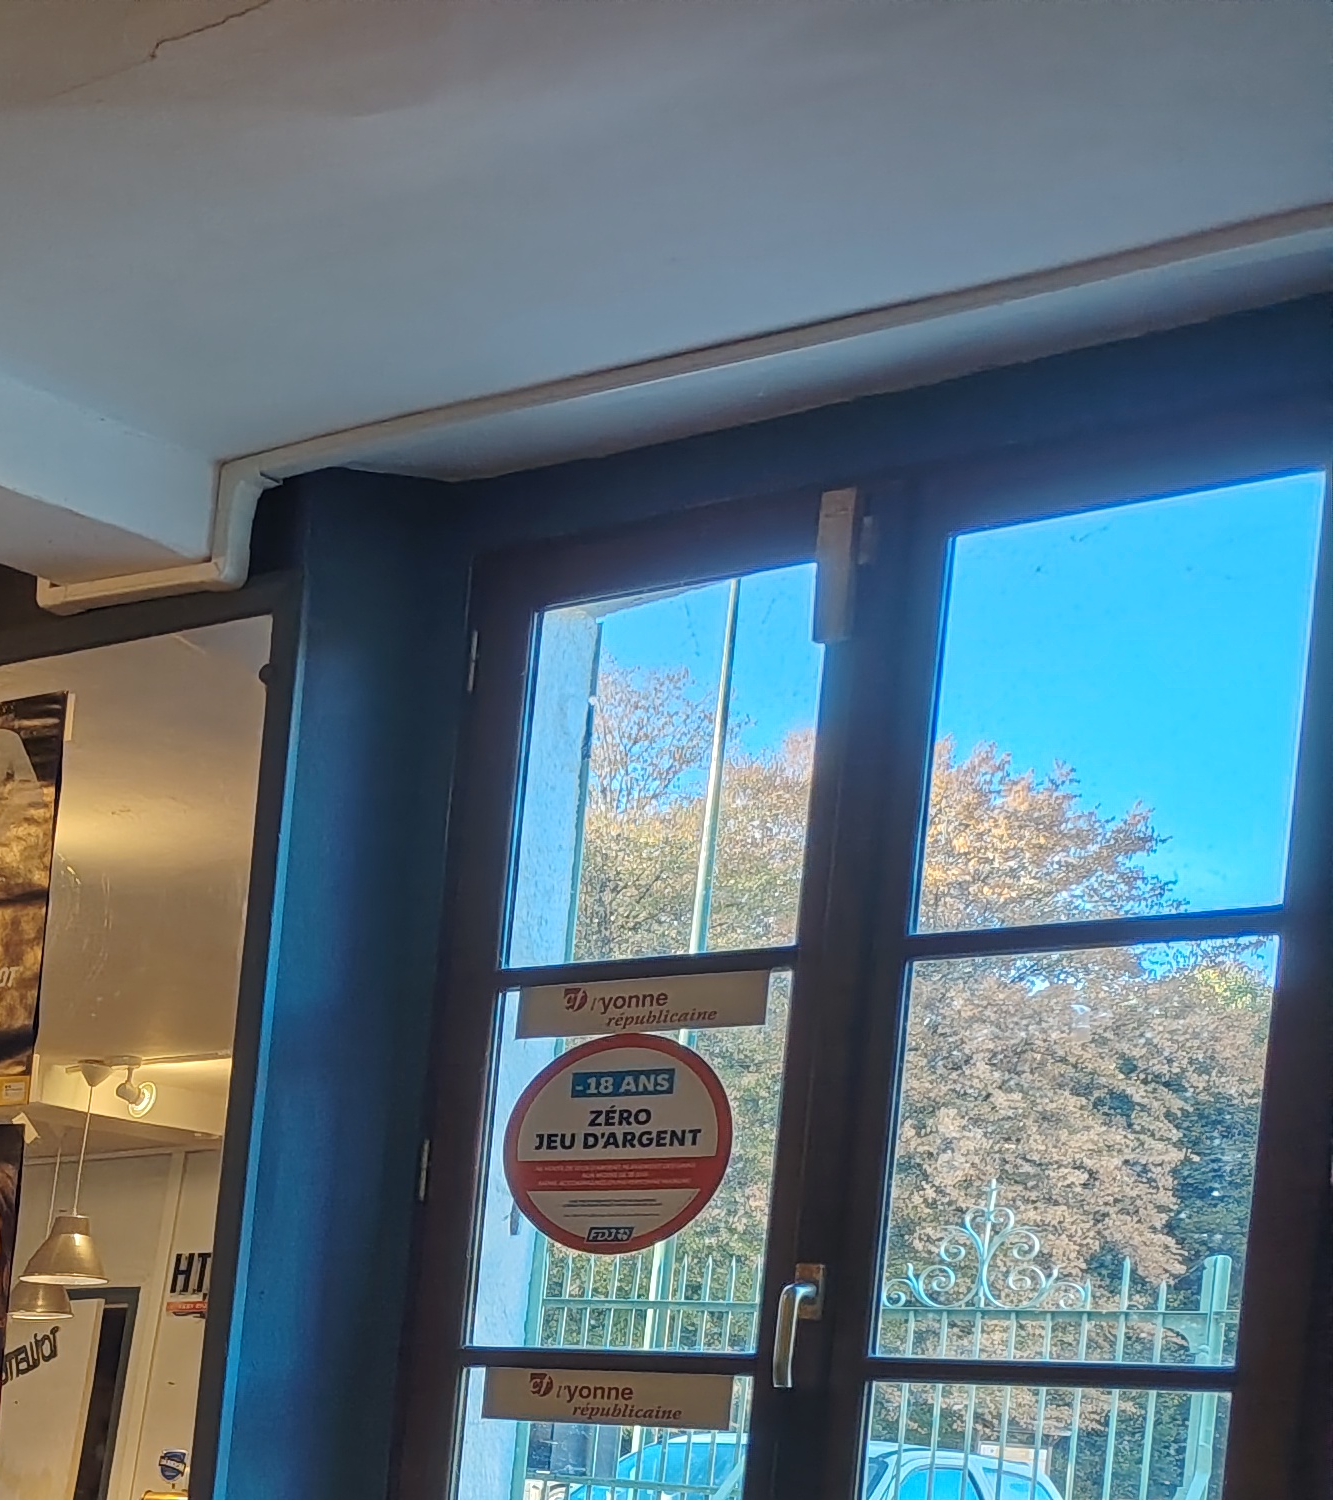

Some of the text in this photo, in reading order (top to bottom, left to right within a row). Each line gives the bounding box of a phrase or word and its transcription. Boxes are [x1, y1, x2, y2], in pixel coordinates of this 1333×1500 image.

[606, 1009, 718, 1029] républicaine
[619, 1074, 670, 1093] ANS
[588, 1105, 652, 1127] ZÉRO
[534, 1129, 702, 1151] JEU D'ARGENT
[588, 1229, 617, 1240] FDJ
[572, 1402, 683, 1420] républicaine
